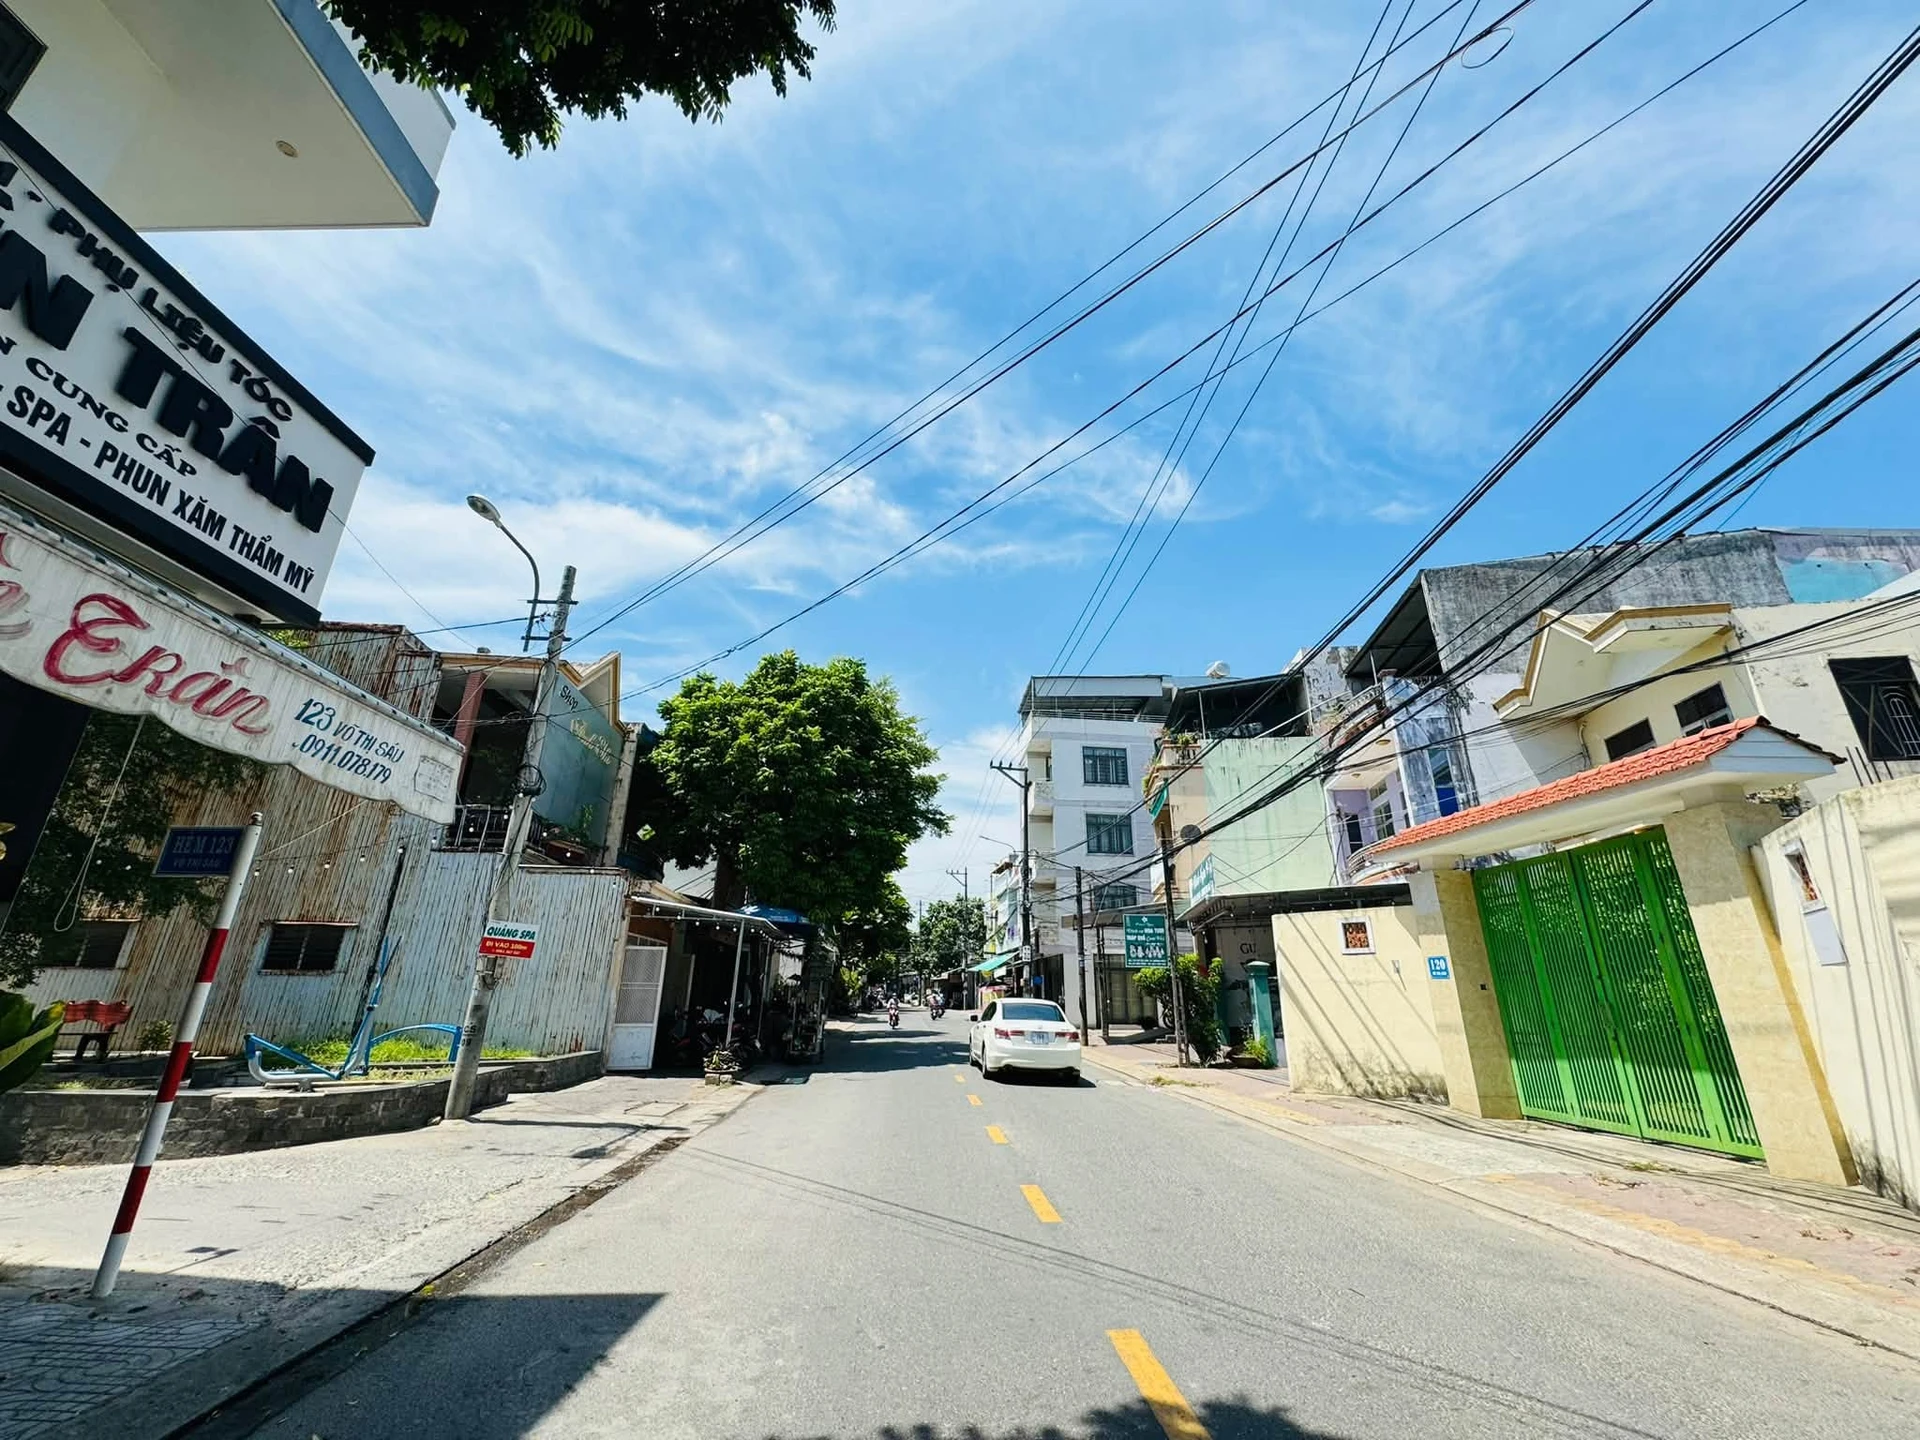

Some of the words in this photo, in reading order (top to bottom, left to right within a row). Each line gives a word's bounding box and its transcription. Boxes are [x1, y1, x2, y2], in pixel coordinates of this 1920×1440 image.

[48, 207, 139, 292] PHỤ
[141, 287, 226, 363] LIỆU
[230, 357, 293, 421] TÓC
[26, 357, 129, 432] CUNG
[136, 433, 197, 477] CẤP
[115, 325, 334, 534] TRÂN
[7, 385, 71, 446] SPA
[94, 440, 171, 507] PHUN
[173, 489, 227, 541] XĂM
[229, 525, 284, 577] THẨM
[283, 560, 315, 594] MỸ
[294, 698, 336, 731] 123
[333, 720, 359, 741] VÕ
[353, 730, 377, 754] THỊ
[375, 742, 405, 763] SÁU
[560, 685, 578, 711] Shop
[209, 835, 235, 854] 123
[519, 929, 536, 940] SPA
[1430, 959, 1446, 970] 120
